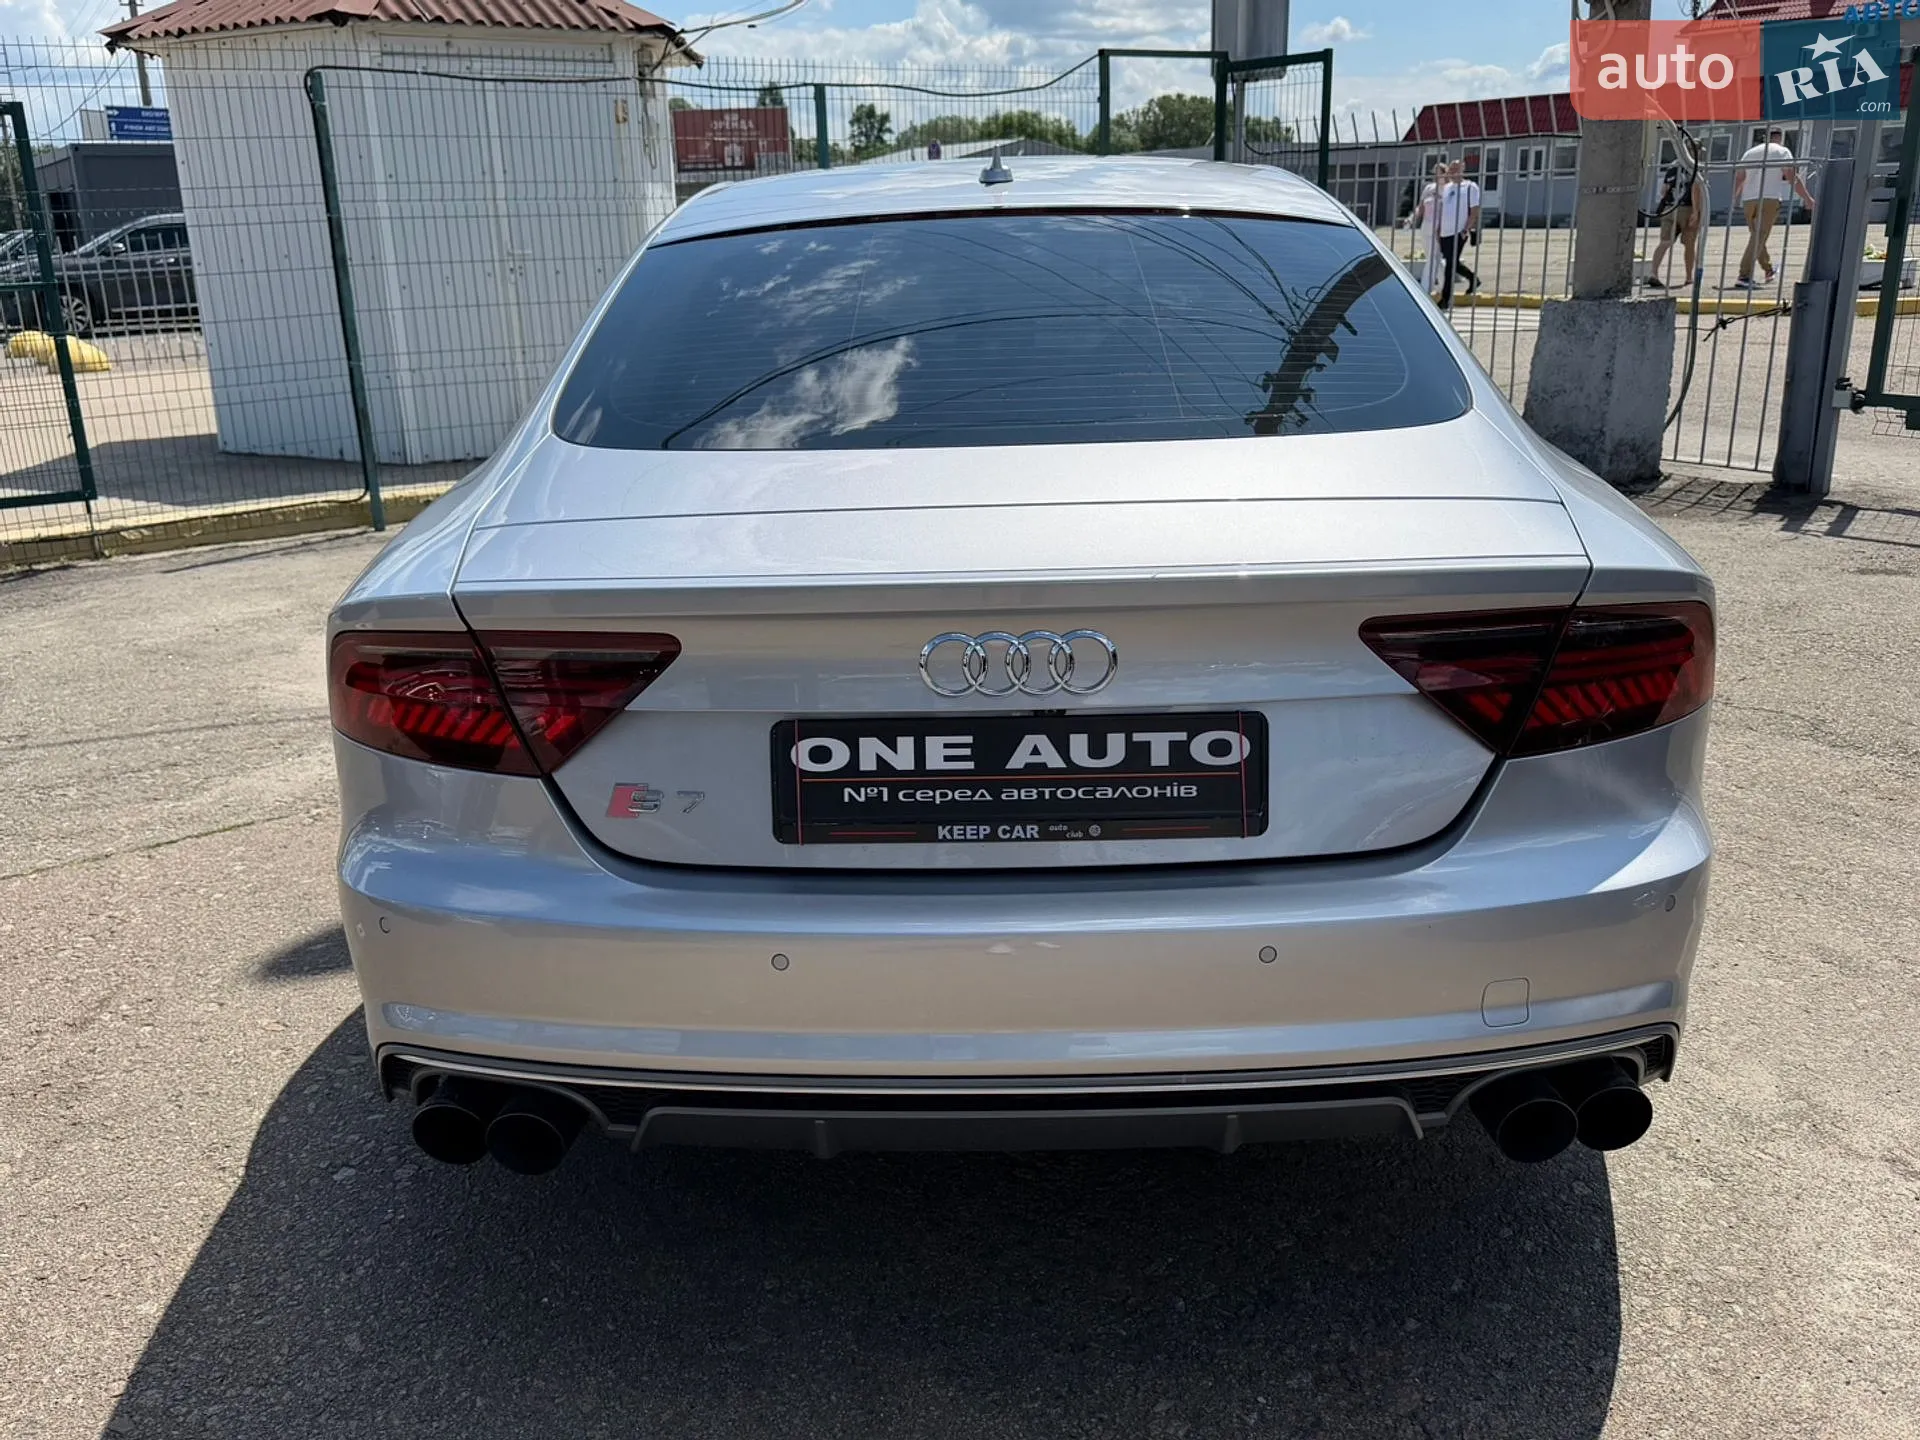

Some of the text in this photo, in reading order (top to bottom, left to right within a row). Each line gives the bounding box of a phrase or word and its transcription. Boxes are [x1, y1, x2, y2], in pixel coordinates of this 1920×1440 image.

[790, 730, 1251, 772] ONE AUTO
[898, 788, 993, 804] серед
[1001, 782, 1198, 800] автосалонів
[937, 825, 1040, 840] KEEP CAR
